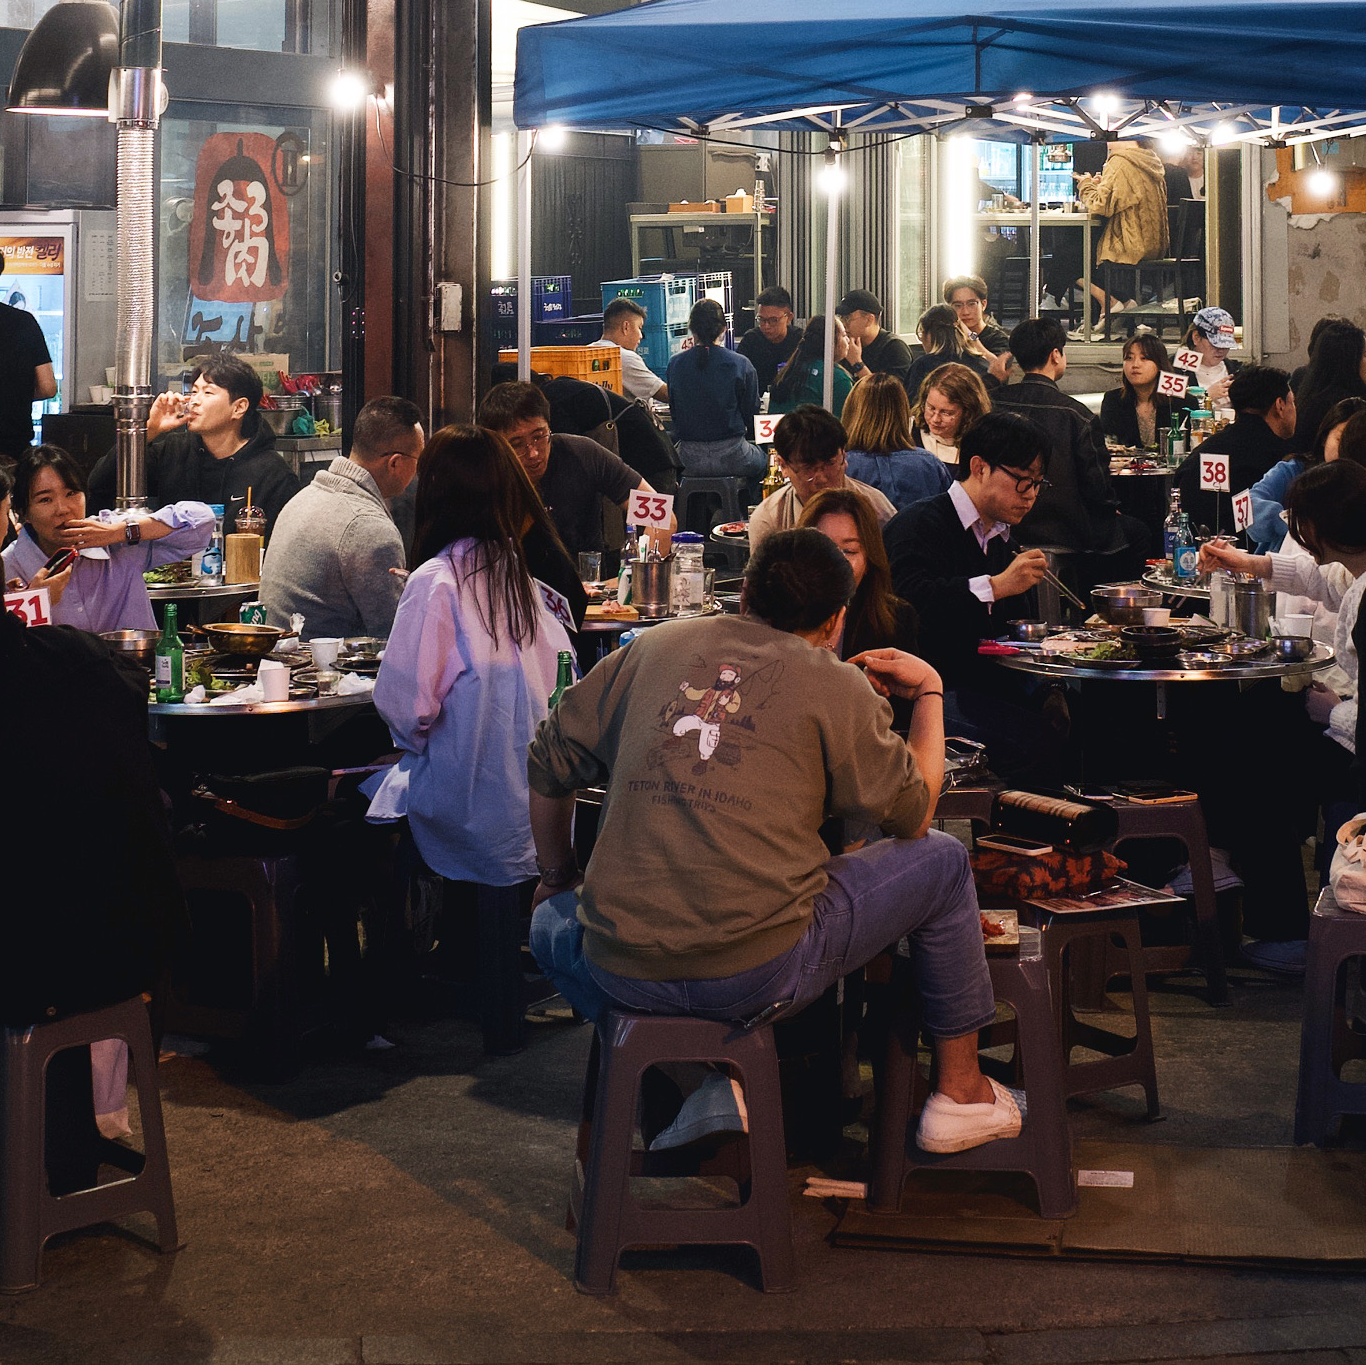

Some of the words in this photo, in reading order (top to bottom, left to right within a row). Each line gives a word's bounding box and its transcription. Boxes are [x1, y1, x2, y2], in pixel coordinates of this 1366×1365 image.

[1178, 352, 1199, 368] 42
[1161, 374, 1185, 393] 35
[759, 420, 777, 438] 3
[1202, 461, 1227, 484] 38
[633, 495, 668, 522] 33
[1235, 496, 1249, 527] 37
[5, 594, 49, 626] 31
[541, 586, 571, 622] 36
[628, 779, 661, 792] TETON
[698, 787, 713, 800] IN
[714, 791, 753, 812] IDAHO
